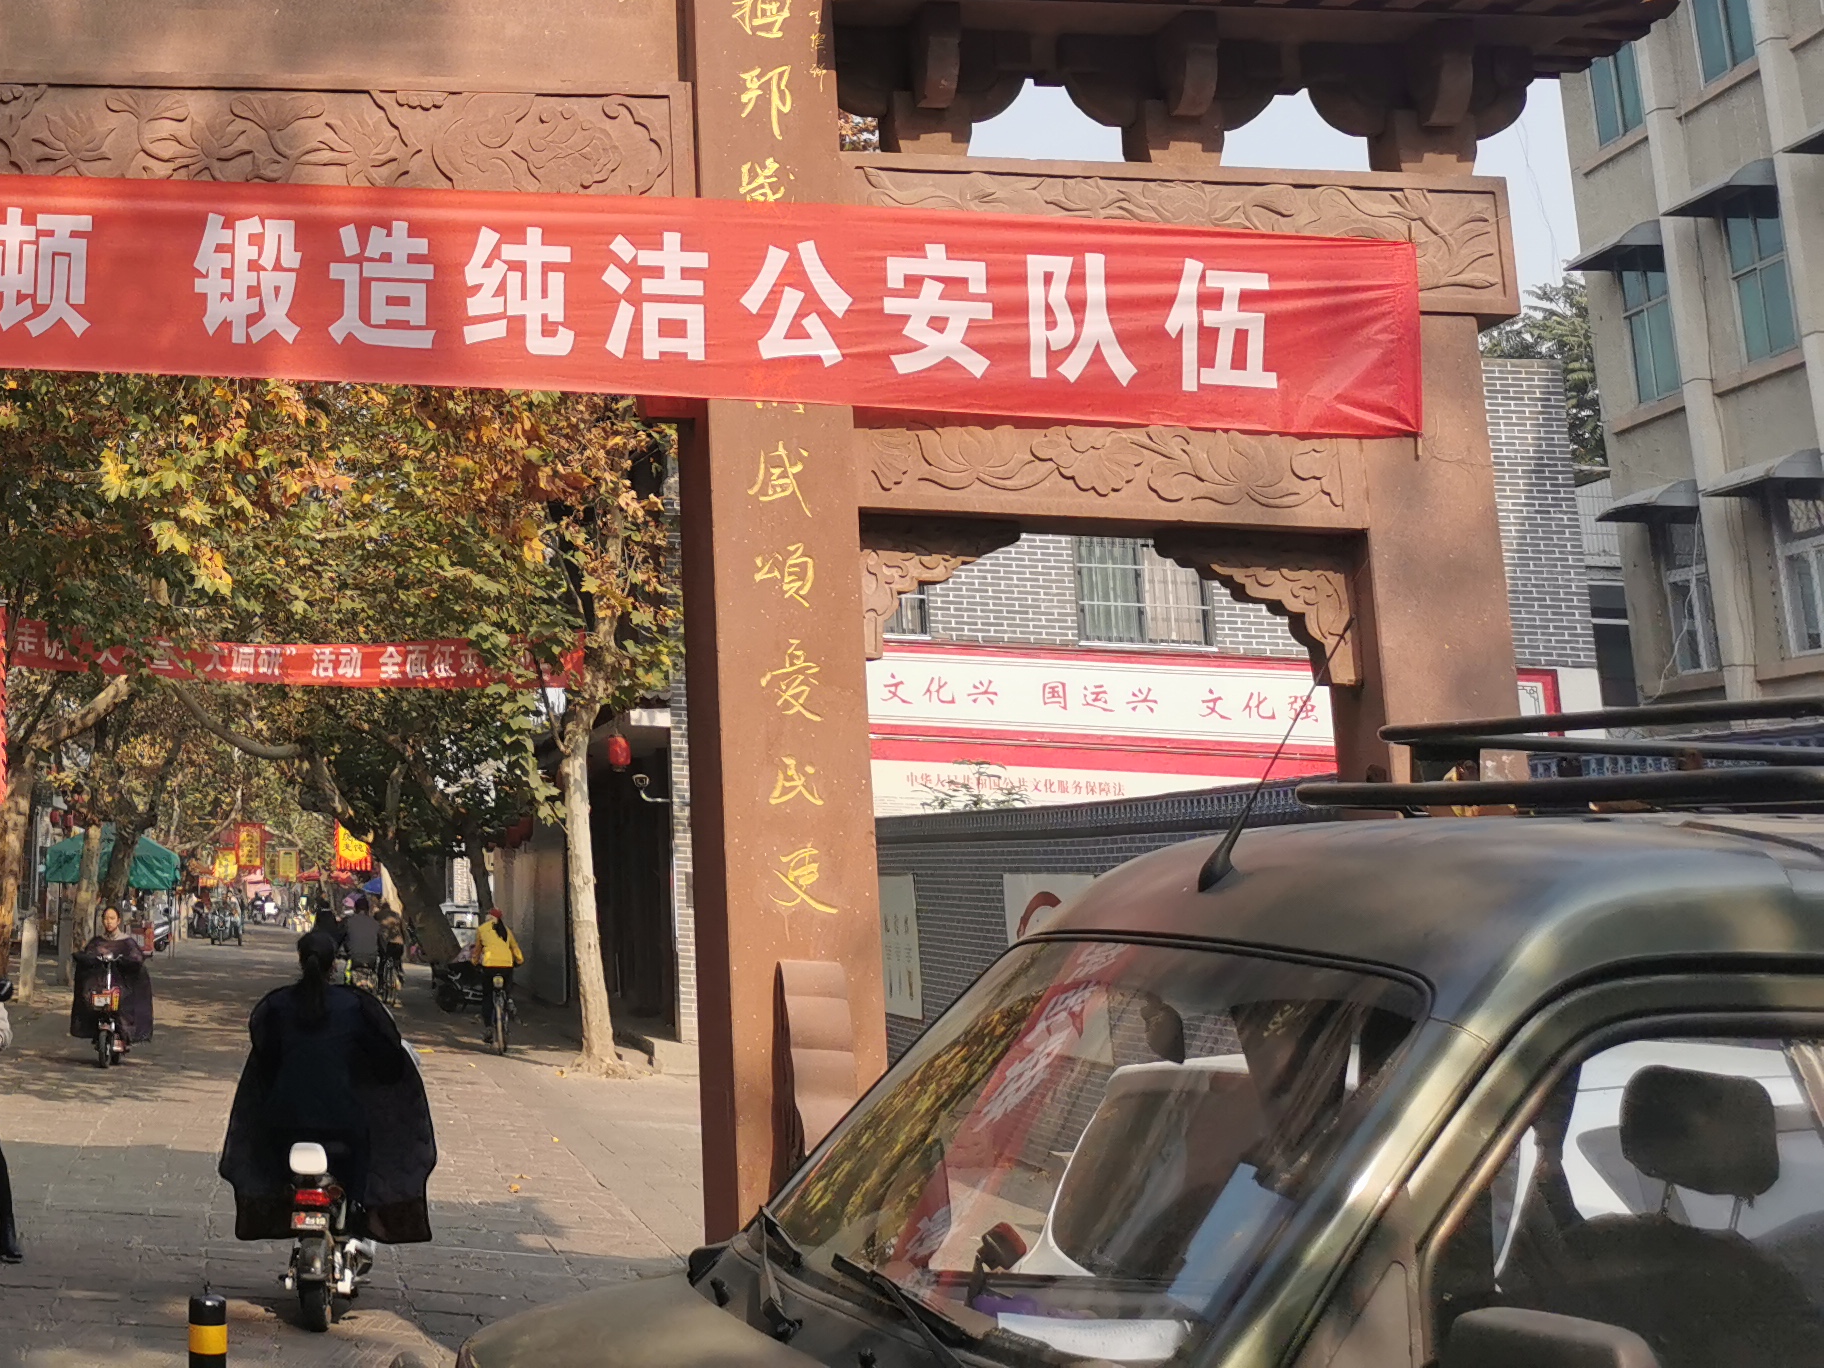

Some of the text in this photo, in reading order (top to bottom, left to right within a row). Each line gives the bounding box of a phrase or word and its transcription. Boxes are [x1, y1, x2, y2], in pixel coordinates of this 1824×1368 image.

[191, 210, 1281, 393] 锻造纯洁公安队伍
[880, 672, 1320, 724] 文化兴 国运兴 文化强
